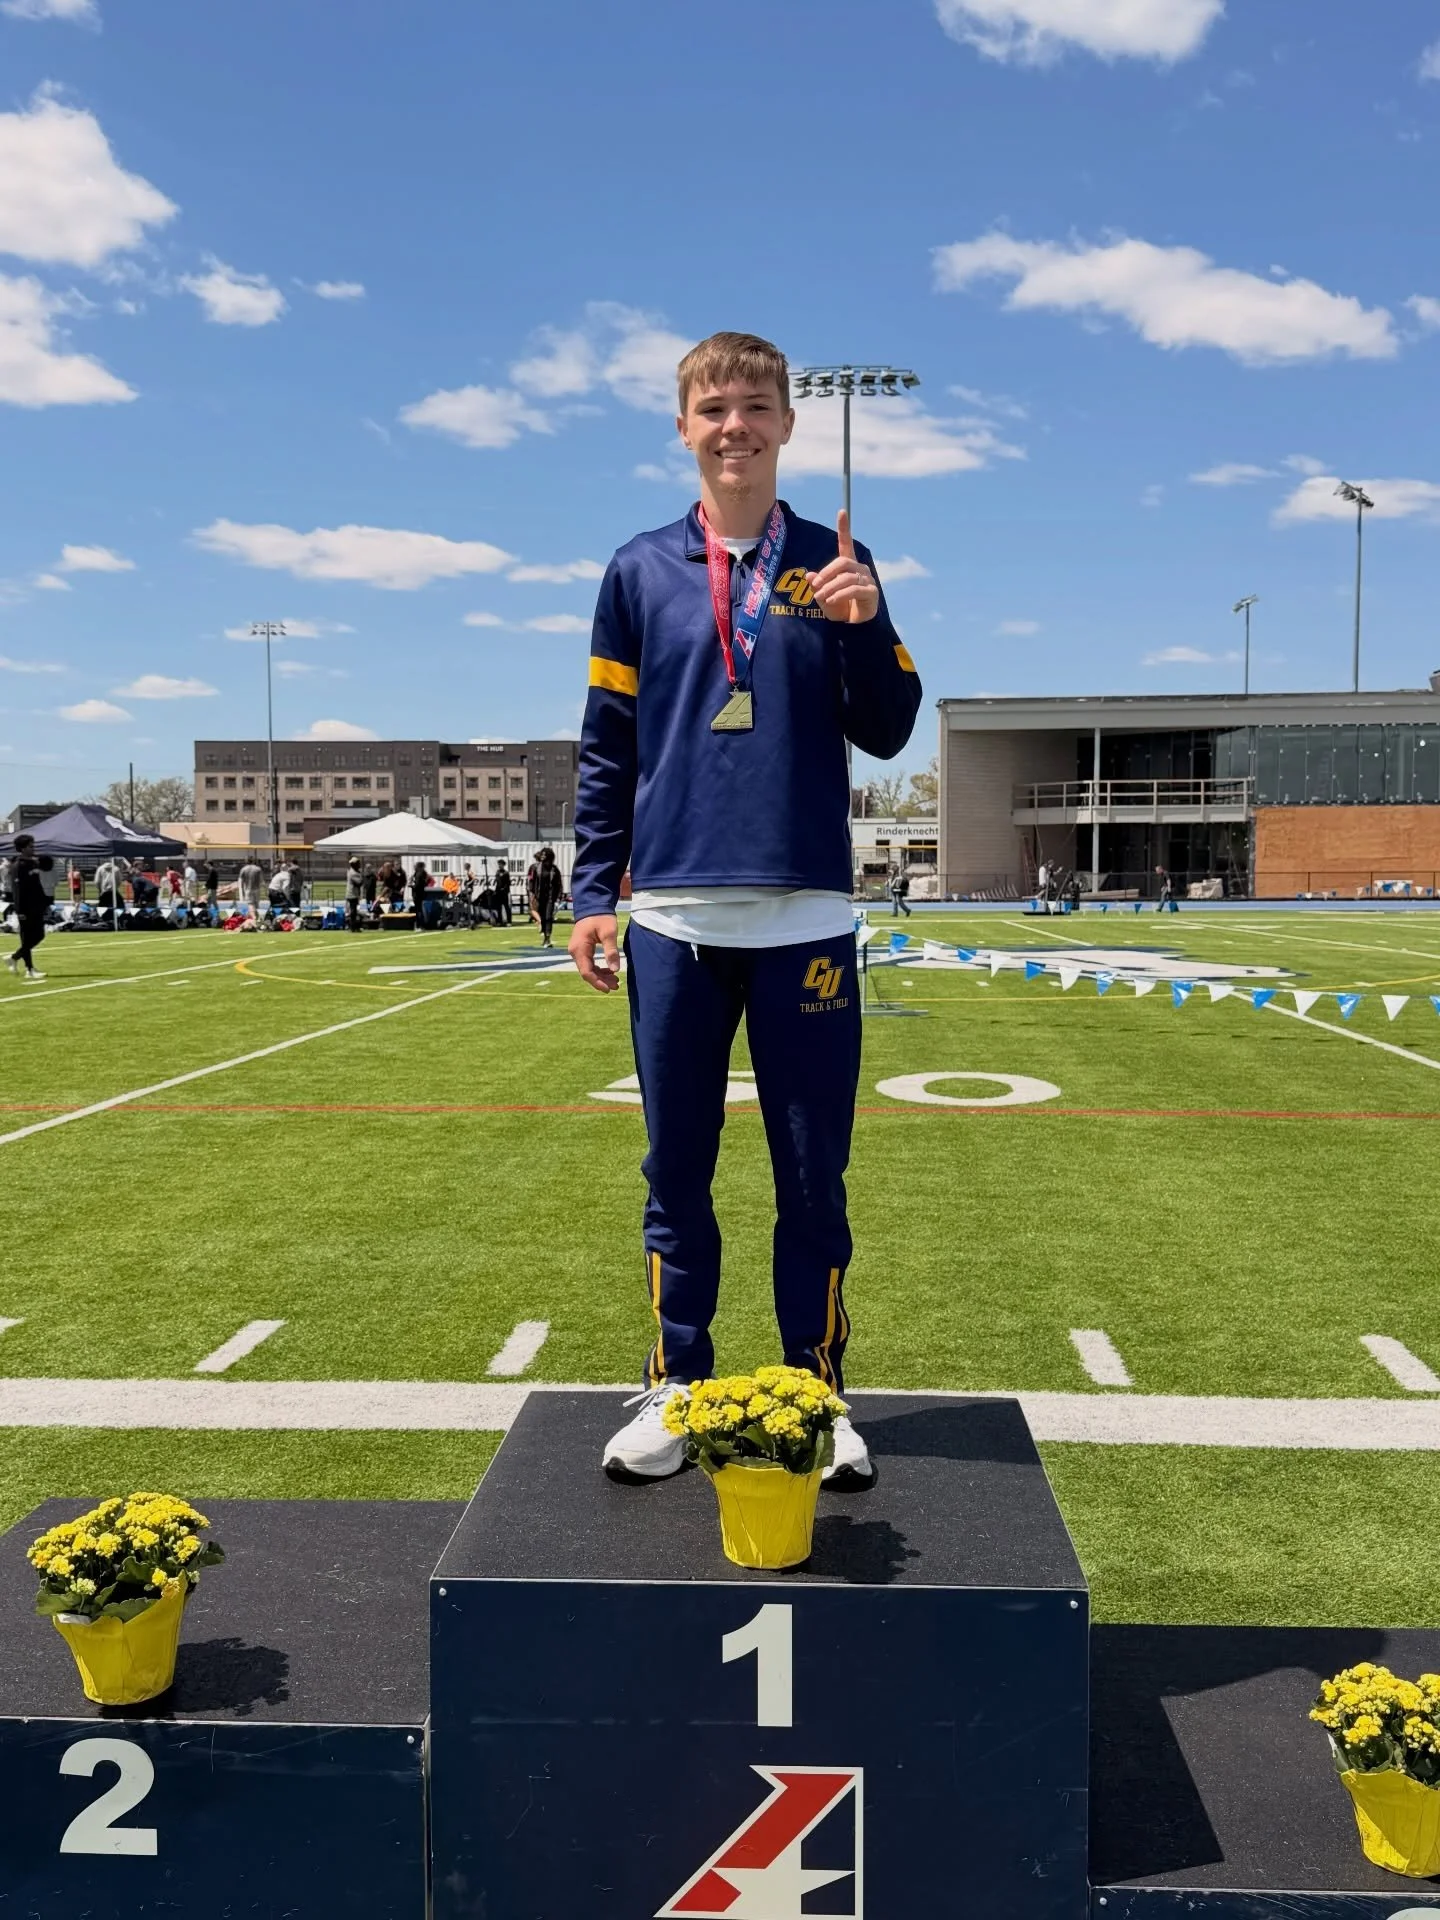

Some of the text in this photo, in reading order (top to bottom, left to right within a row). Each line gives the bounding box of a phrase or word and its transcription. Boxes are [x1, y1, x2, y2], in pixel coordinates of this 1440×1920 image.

[744, 557, 769, 618] HEART
[761, 538, 771, 558] OF
[769, 605, 796, 616] TRACK
[798, 607, 804, 617] &
[876, 826, 939, 836] Rinderknecht
[802, 956, 844, 999] CU
[800, 998, 849, 1013] TRACK & FIELD
[722, 1603, 793, 1728] 1
[59, 1737, 158, 1856] 2
